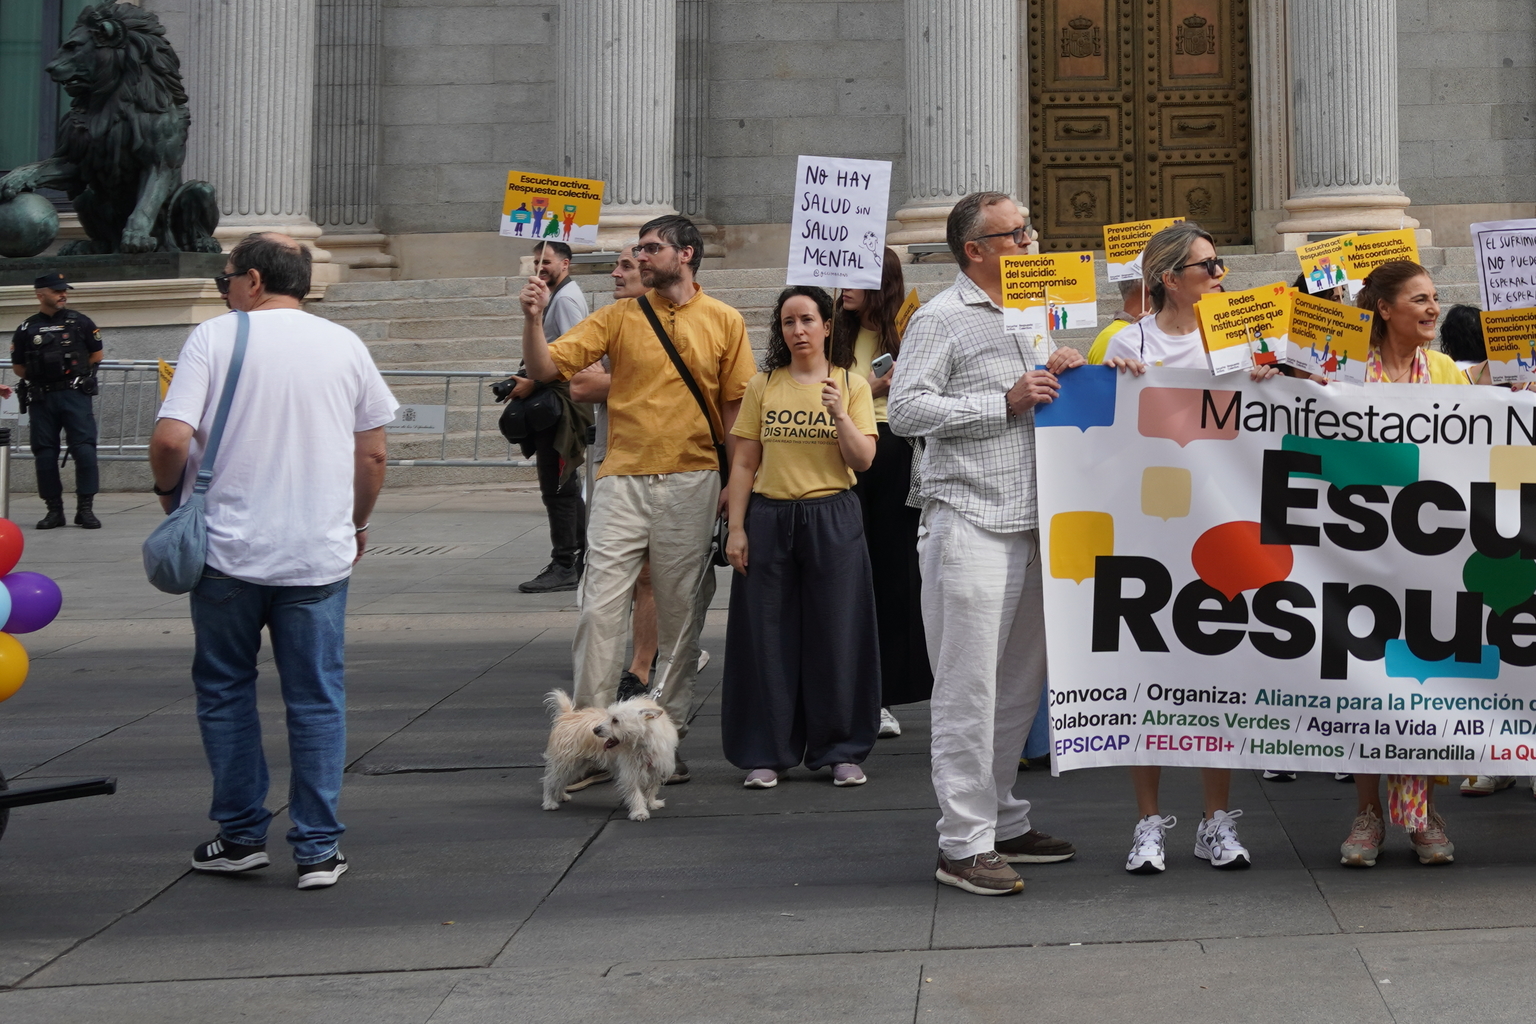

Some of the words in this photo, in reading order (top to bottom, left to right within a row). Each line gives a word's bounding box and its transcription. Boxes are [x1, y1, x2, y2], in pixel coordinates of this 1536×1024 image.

[520, 176, 559, 186] Escucha
[560, 181, 590, 190] activa.
[806, 165, 828, 185] NO
[837, 170, 871, 190] HAY
[509, 183, 556, 194] Respuesta
[558, 190, 600, 200] colectiva.
[802, 192, 850, 214] SALUD
[802, 219, 848, 241] SALUD
[1355, 242, 1371, 251] Más
[1372, 238, 1404, 249] escucha.
[1486, 238, 1496, 249] EL
[804, 246, 864, 269] MENTAL
[1348, 252, 1365, 261] Más
[1365, 245, 1412, 258] coordinación.
[1005, 257, 1054, 268] Prevención
[1353, 259, 1370, 269] Más
[1488, 256, 1505, 270] NO
[1005, 270, 1019, 278] del
[1021, 268, 1056, 278] suicidio:
[1019, 277, 1077, 290] compromiso
[1490, 277, 1527, 288] ESPERAR
[1228, 294, 1255, 306] Redes
[1493, 293, 1501, 305] DE
[1213, 311, 1230, 321] que
[1231, 300, 1276, 316] escuchan.
[1295, 298, 1344, 319] Comunicación,
[1211, 315, 1265, 332] Instituciones
[1266, 309, 1283, 321] que
[1292, 318, 1309, 329] para
[1309, 322, 1335, 336] prevenir
[1294, 308, 1326, 322] formación
[1332, 319, 1363, 332] recursos
[1292, 326, 1317, 340] suicidio.
[1486, 324, 1524, 333] formación
[1489, 335, 1506, 344] para
[1507, 332, 1536, 343] prevenir
[1490, 343, 1520, 352] suicidio.
[1201, 389, 1492, 445] Manifestación
[764, 427, 838, 439] DISTANCING
[1147, 684, 1246, 706] Organiza:
[1255, 689, 1330, 708] Alianza
[1337, 695, 1382, 713] para
[1389, 693, 1405, 710] la
[1410, 693, 1523, 711] Prevención
[1142, 708, 1220, 728] Abrazos
[1224, 712, 1290, 730] Verdes
[1306, 716, 1370, 737] Agarra
[1375, 720, 1390, 735] la
[1395, 719, 1436, 736] Vida
[1453, 720, 1484, 736] AIB
[1146, 735, 1234, 752] FELGTBI+
[1250, 739, 1344, 757] Hablemos
[1360, 744, 1380, 759] La
[1385, 744, 1474, 761] Barandilla
[1491, 745, 1512, 760] La
